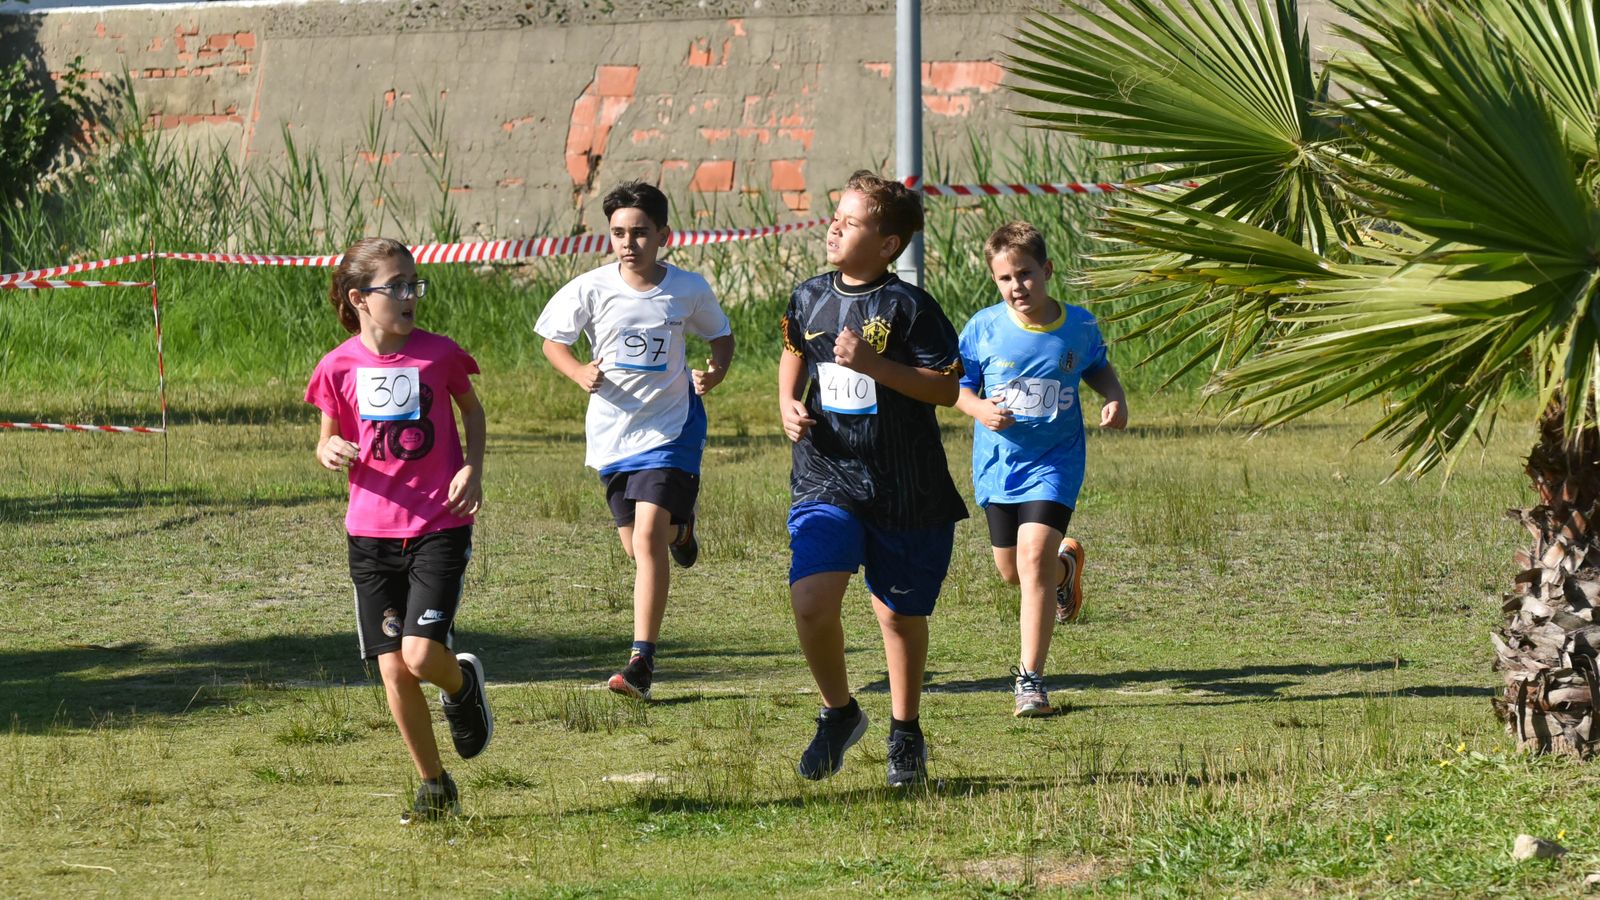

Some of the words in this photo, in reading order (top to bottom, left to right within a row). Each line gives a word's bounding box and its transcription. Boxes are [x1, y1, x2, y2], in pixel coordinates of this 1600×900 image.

[625, 335, 667, 362] 97
[367, 374, 412, 408] 30
[827, 376, 869, 401] 410
[1007, 381, 1056, 410] 250
[423, 609, 444, 619] NIKE
